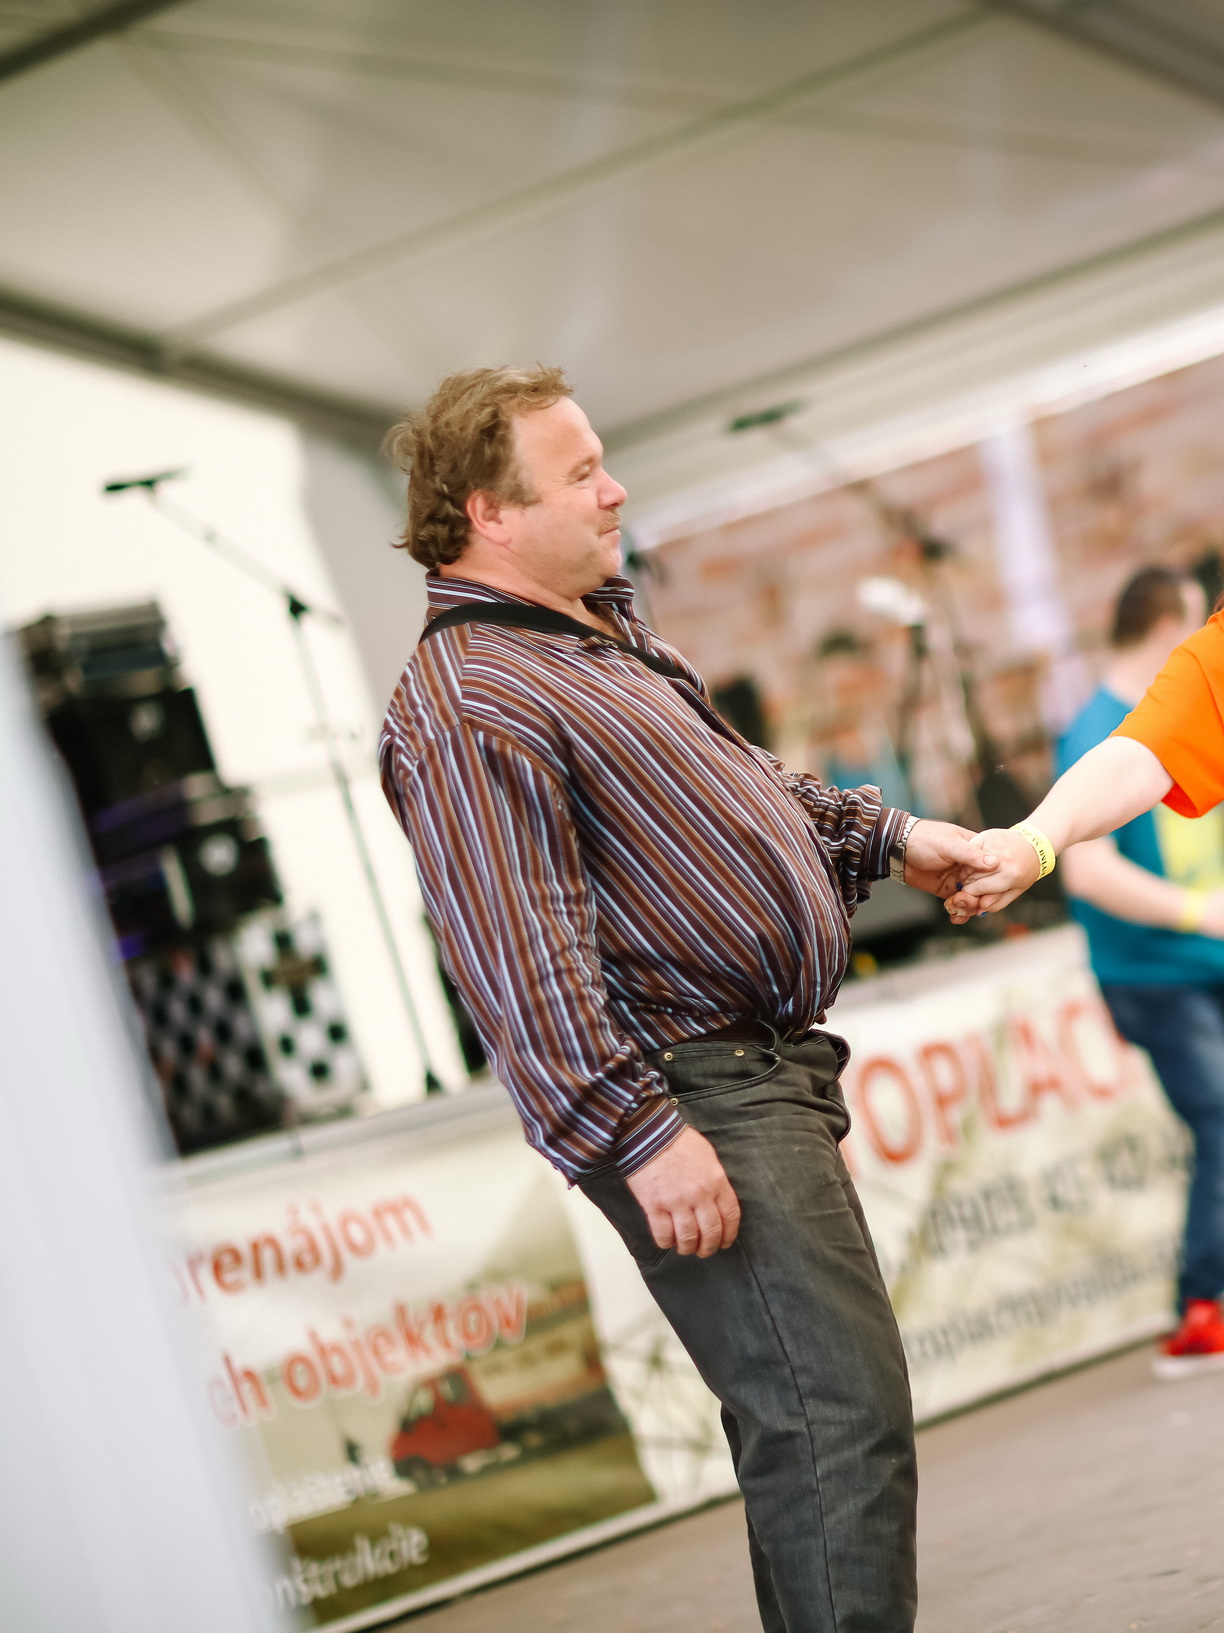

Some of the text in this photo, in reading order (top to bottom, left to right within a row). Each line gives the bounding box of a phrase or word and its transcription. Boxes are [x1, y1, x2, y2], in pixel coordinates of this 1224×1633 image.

[840, 1000, 1142, 1182] OPLAC
[174, 1194, 433, 1303] renájom
[282, 1282, 527, 1400] objektov
[268, 1522, 430, 1610] nštrukcie
